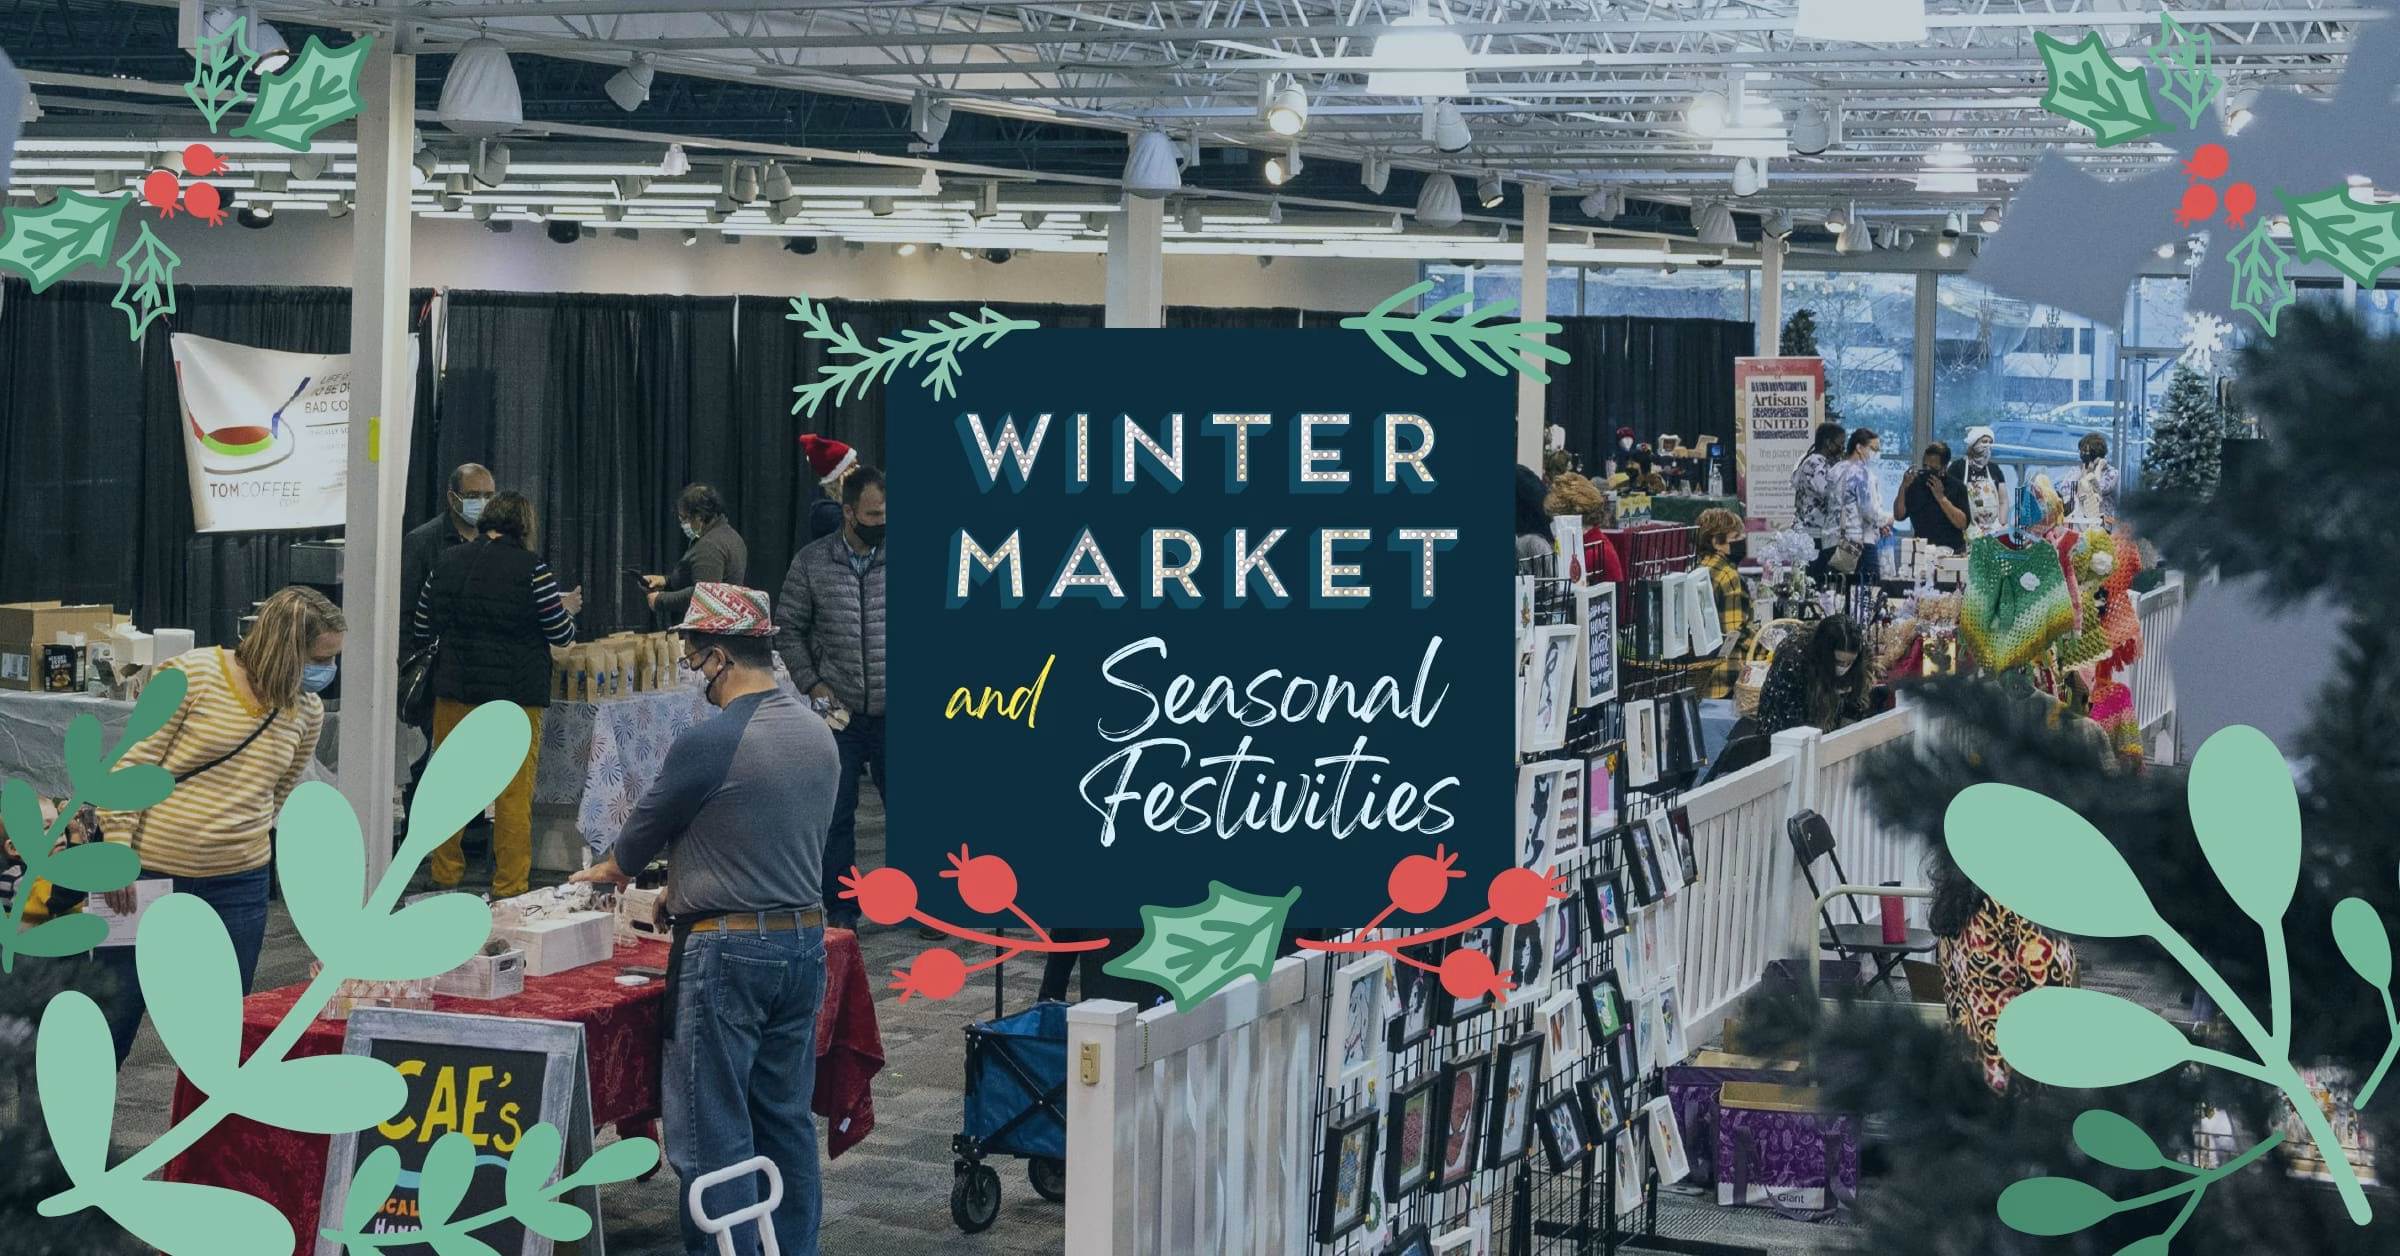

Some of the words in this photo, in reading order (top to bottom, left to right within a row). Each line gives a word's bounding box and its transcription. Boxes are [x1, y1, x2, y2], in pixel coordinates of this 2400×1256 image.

[304, 401, 328, 413] BAD
[331, 399, 350, 412] CO
[1752, 392, 1808, 407] Artisans
[1752, 418, 1809, 430] UNITED
[209, 481, 302, 498] TOMCOFFEE
[1777, 1193, 1804, 1204] Giant
